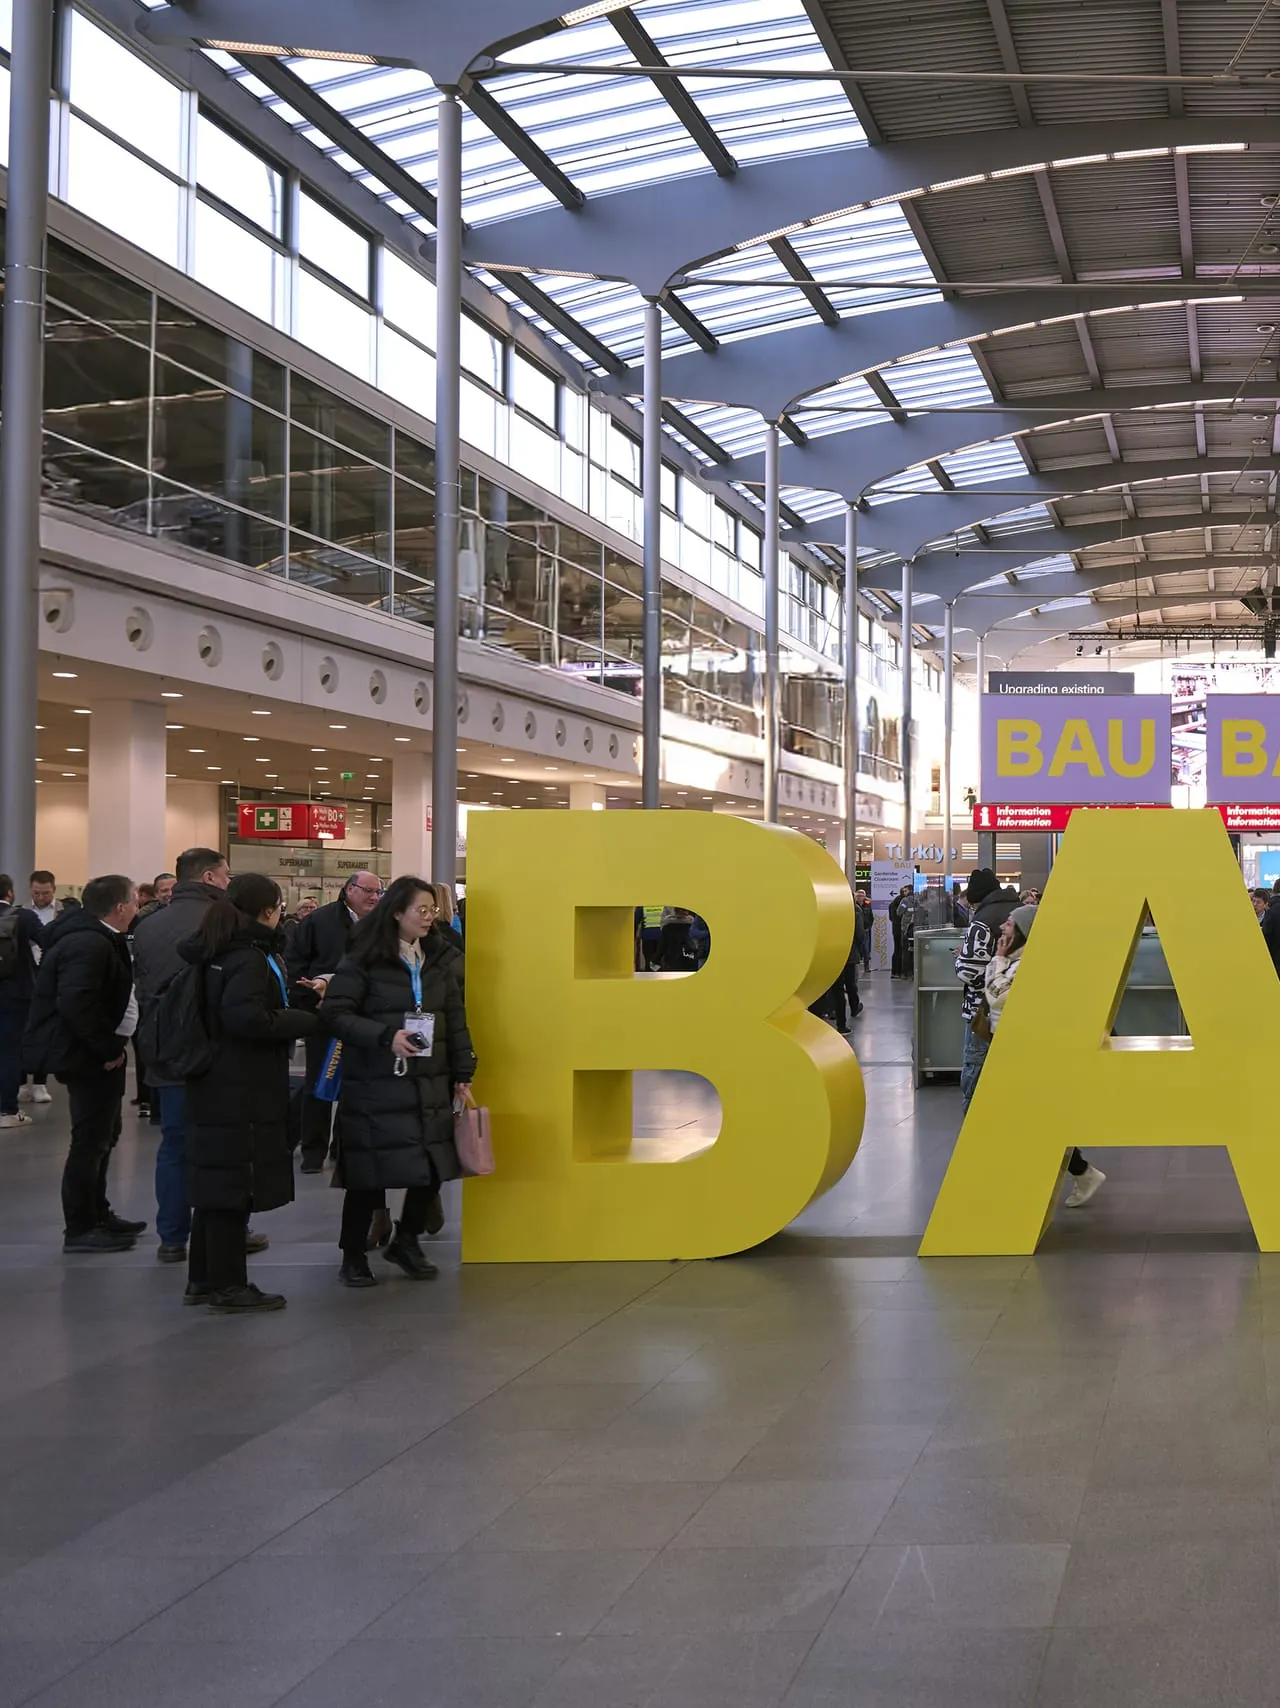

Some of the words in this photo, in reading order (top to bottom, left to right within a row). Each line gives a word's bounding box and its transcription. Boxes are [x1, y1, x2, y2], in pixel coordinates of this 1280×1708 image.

[1061, 683, 1105, 694] existing
[997, 719, 1156, 778] BAU
[996, 806, 1051, 816] Information
[1226, 806, 1280, 816] Information
[996, 817, 1052, 827] Information
[1226, 817, 1280, 826] Information
[279, 858, 313, 867] SUPERMARKT
[337, 861, 369, 869] SUPERMARKET
[325, 1040, 343, 1080] RMANN
